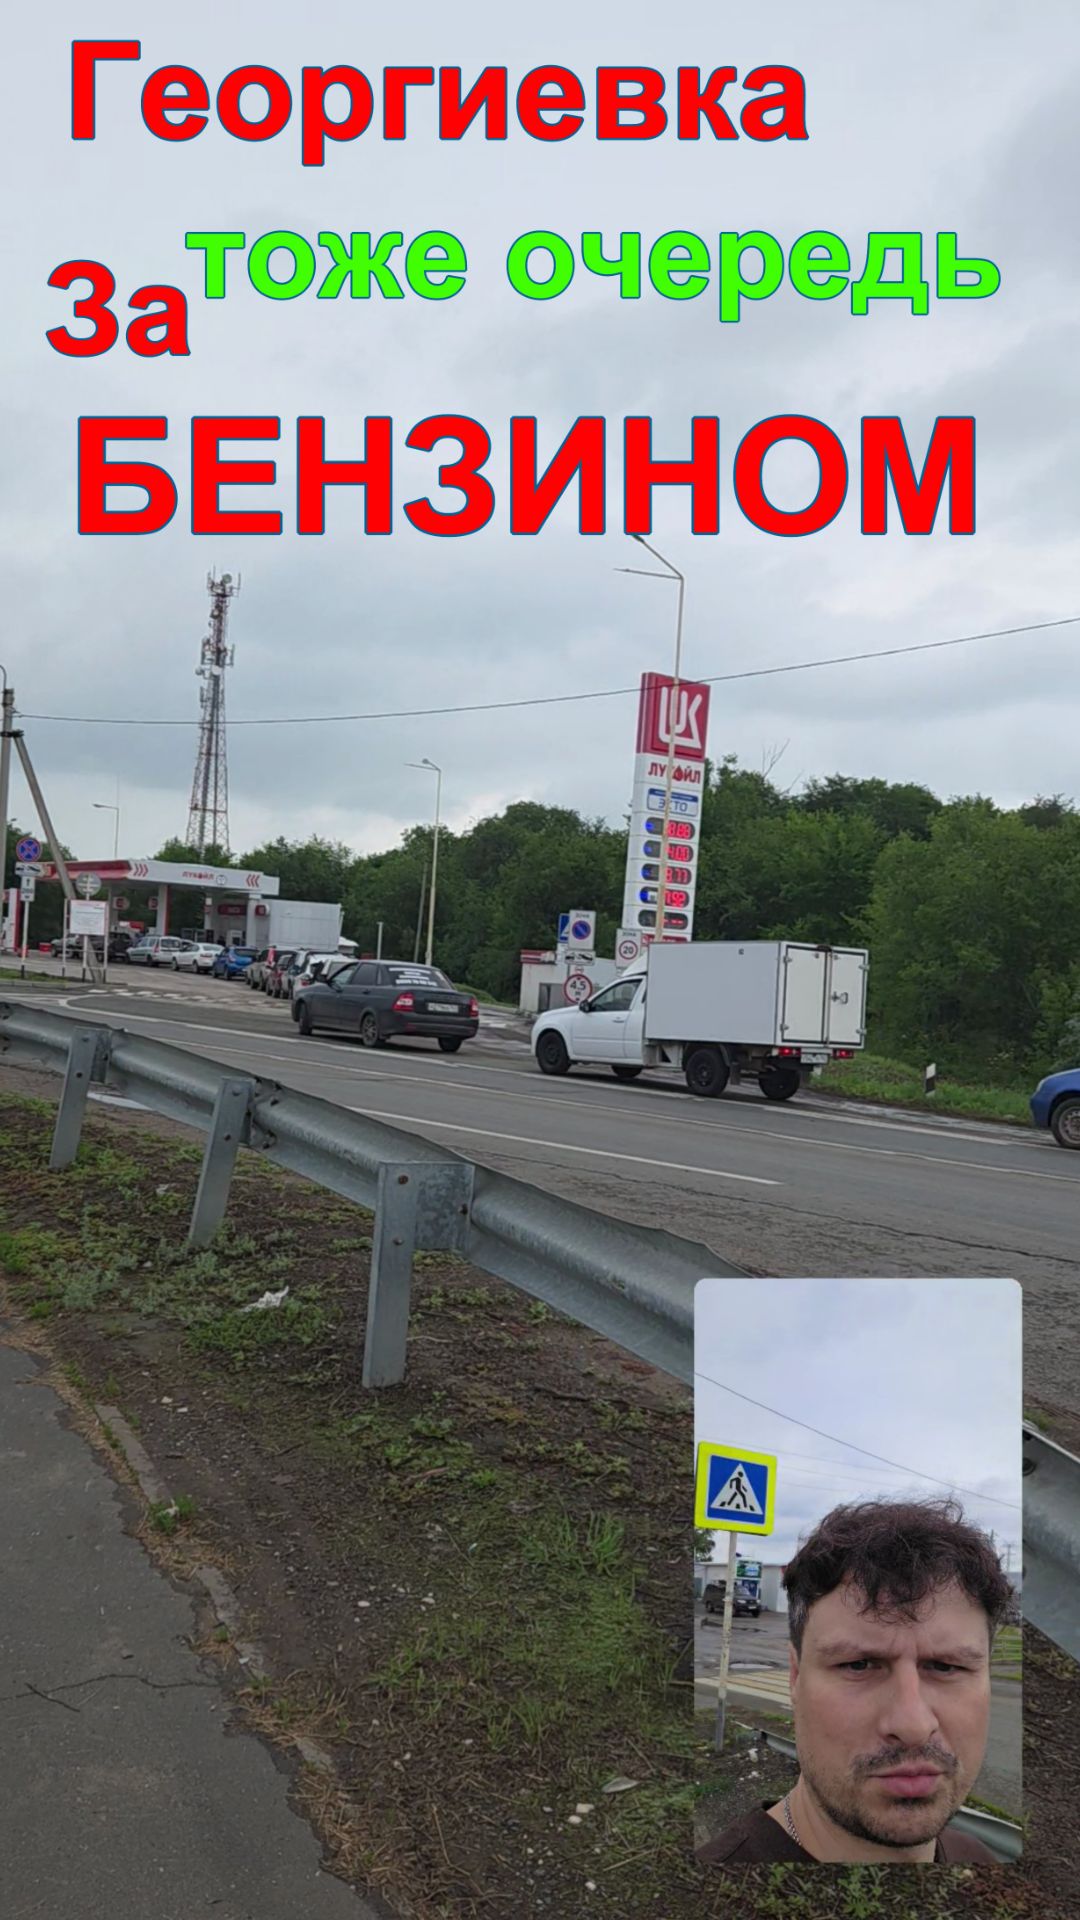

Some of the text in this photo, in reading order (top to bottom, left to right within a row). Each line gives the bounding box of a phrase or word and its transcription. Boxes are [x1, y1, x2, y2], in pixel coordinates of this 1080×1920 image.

[647, 762, 701, 784] ЛУОЙЛ
[658, 798, 688, 812] ЭТО
[623, 945, 634, 955] 20
